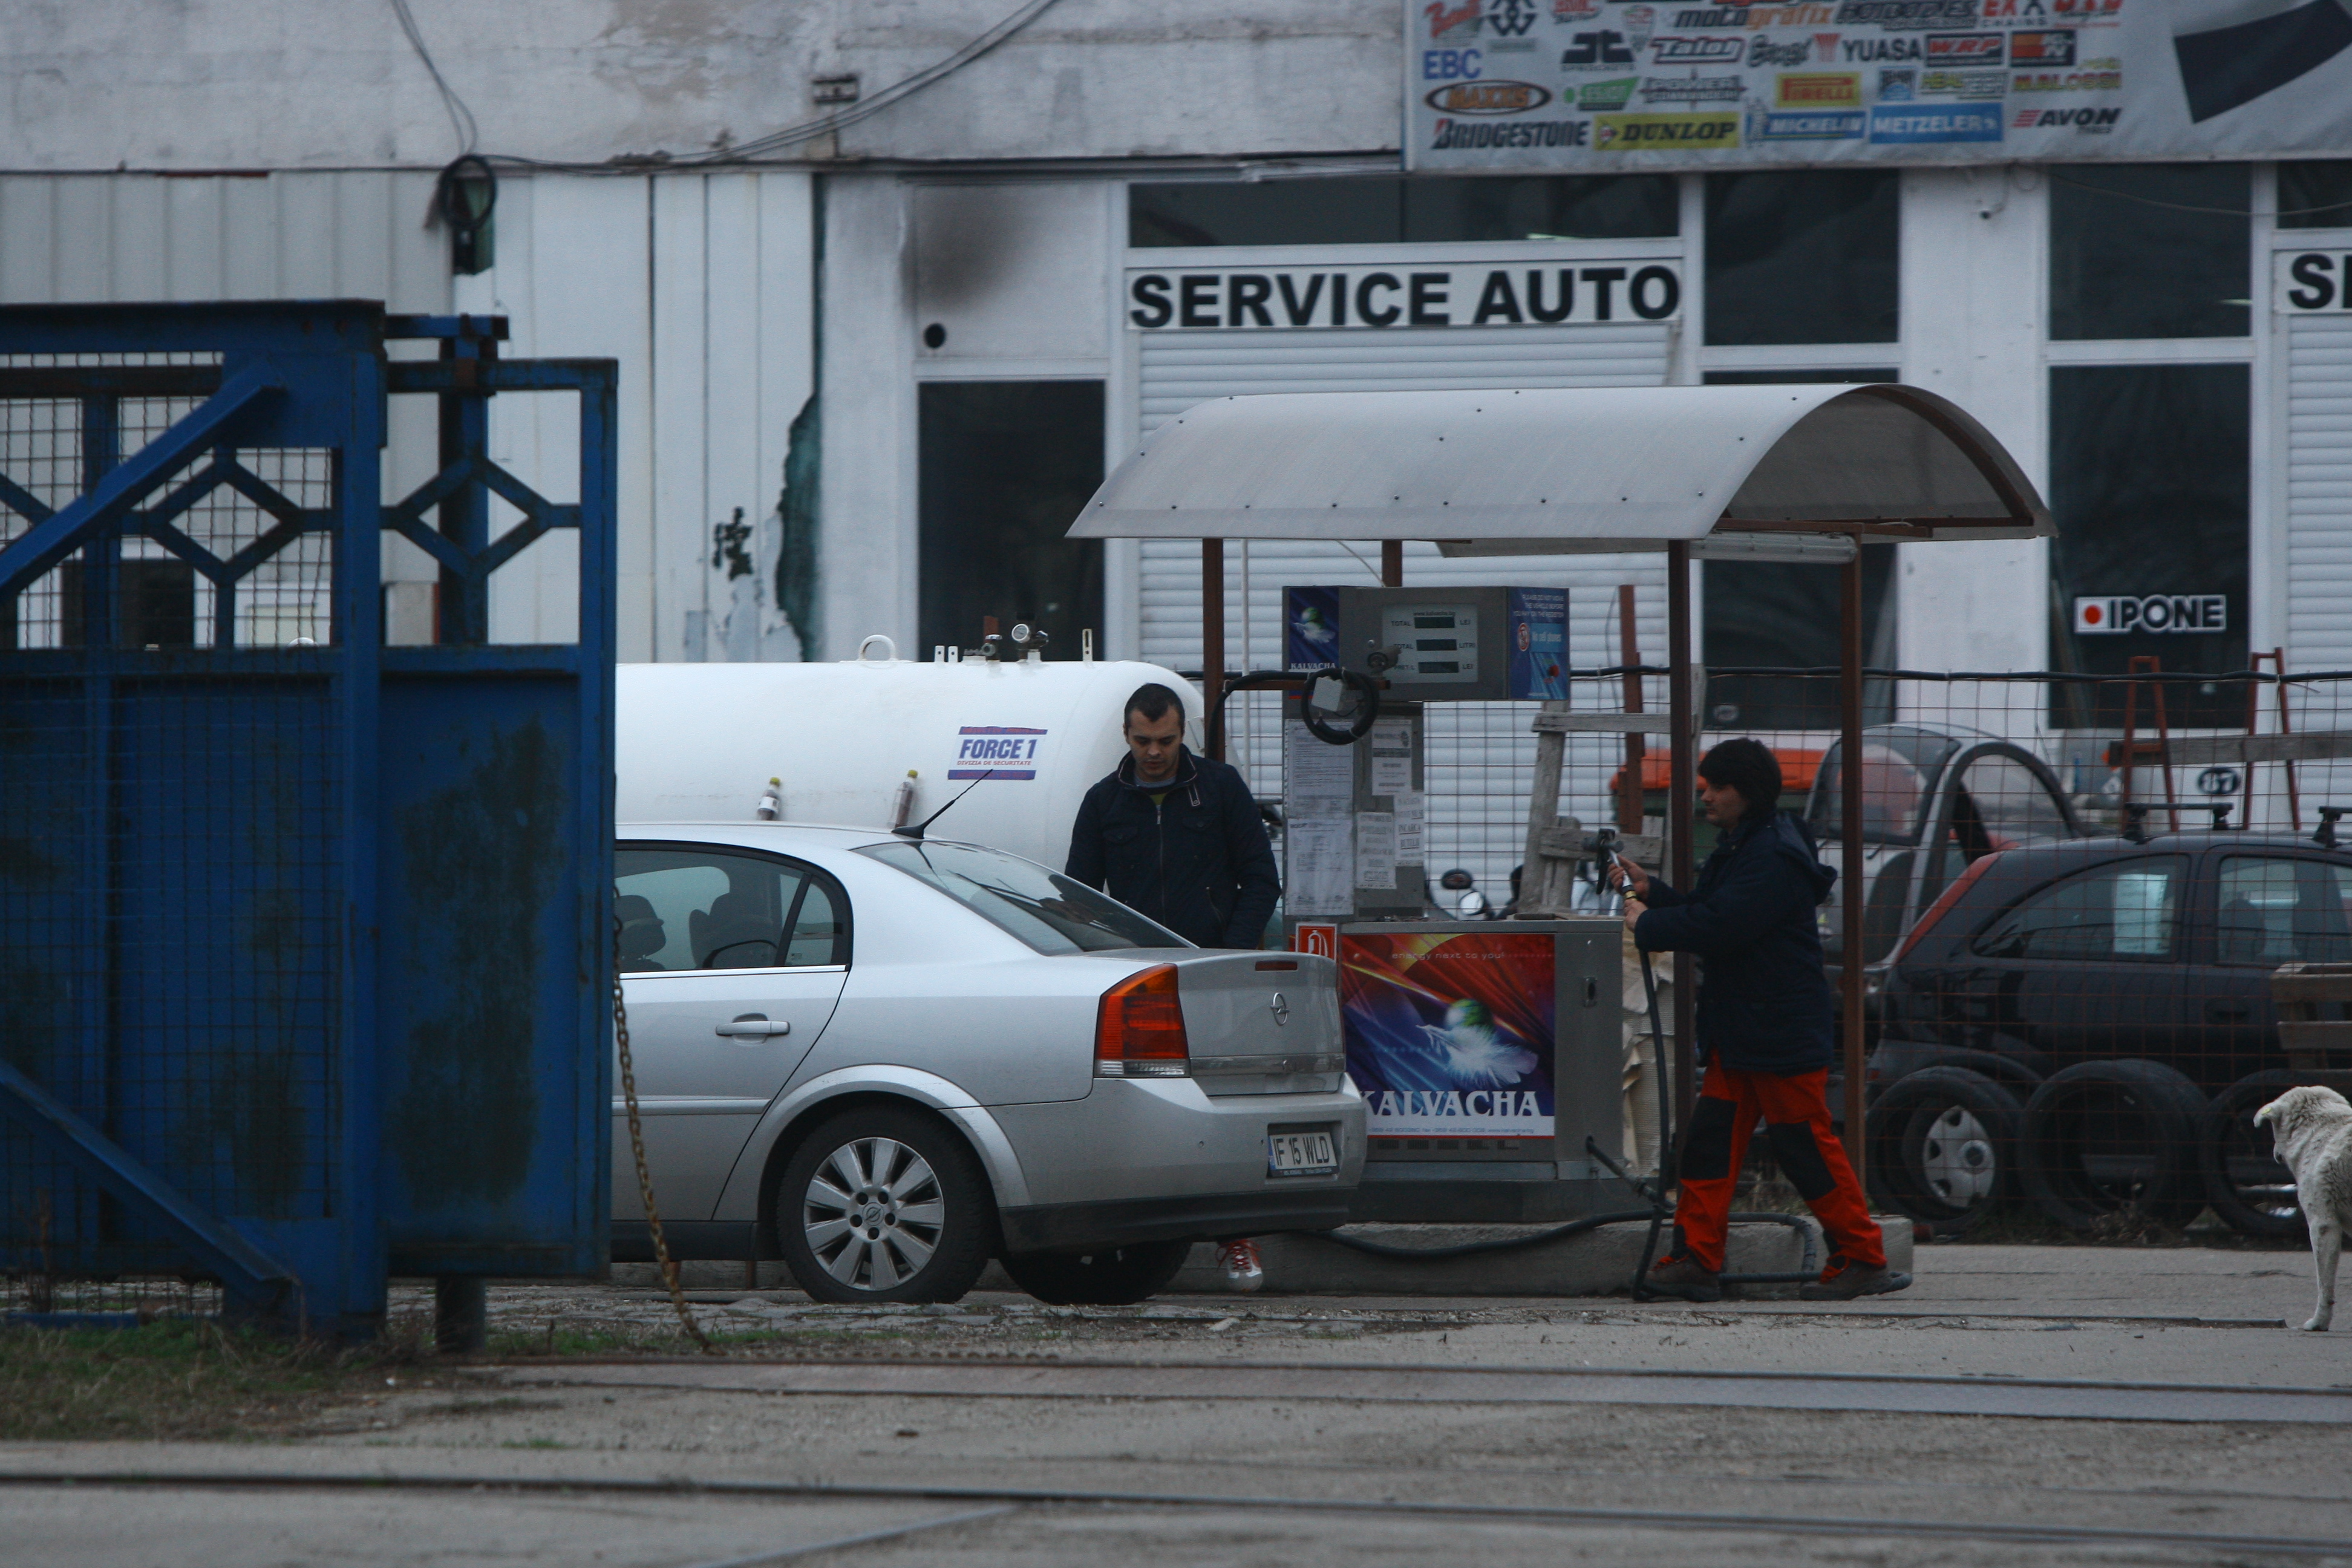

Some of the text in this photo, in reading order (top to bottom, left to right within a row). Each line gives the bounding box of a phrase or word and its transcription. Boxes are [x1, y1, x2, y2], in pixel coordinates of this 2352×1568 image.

[1843, 38, 1921, 61] YUASA
[1929, 38, 2001, 54] WRP
[1423, 48, 1481, 79] EBC
[1783, 77, 1854, 100] PIRELLI
[2013, 72, 2122, 91] MALOSSI
[1446, 86, 1530, 109] MAXXIS
[1769, 117, 1862, 132] MICHELIN
[1874, 115, 1982, 134] METZELER
[2037, 107, 2123, 126] AVON
[1431, 118, 1590, 149] BRIDGESTONE
[1622, 122, 1736, 140] DUNLOP
[2288, 253, 2352, 309] S
[1129, 265, 1679, 328] SERVICE AUTO
[2110, 595, 2224, 633] IPONE
[959, 739, 1037, 759] FORCE 1
[1273, 1136, 1330, 1166] IF 15 WLD
